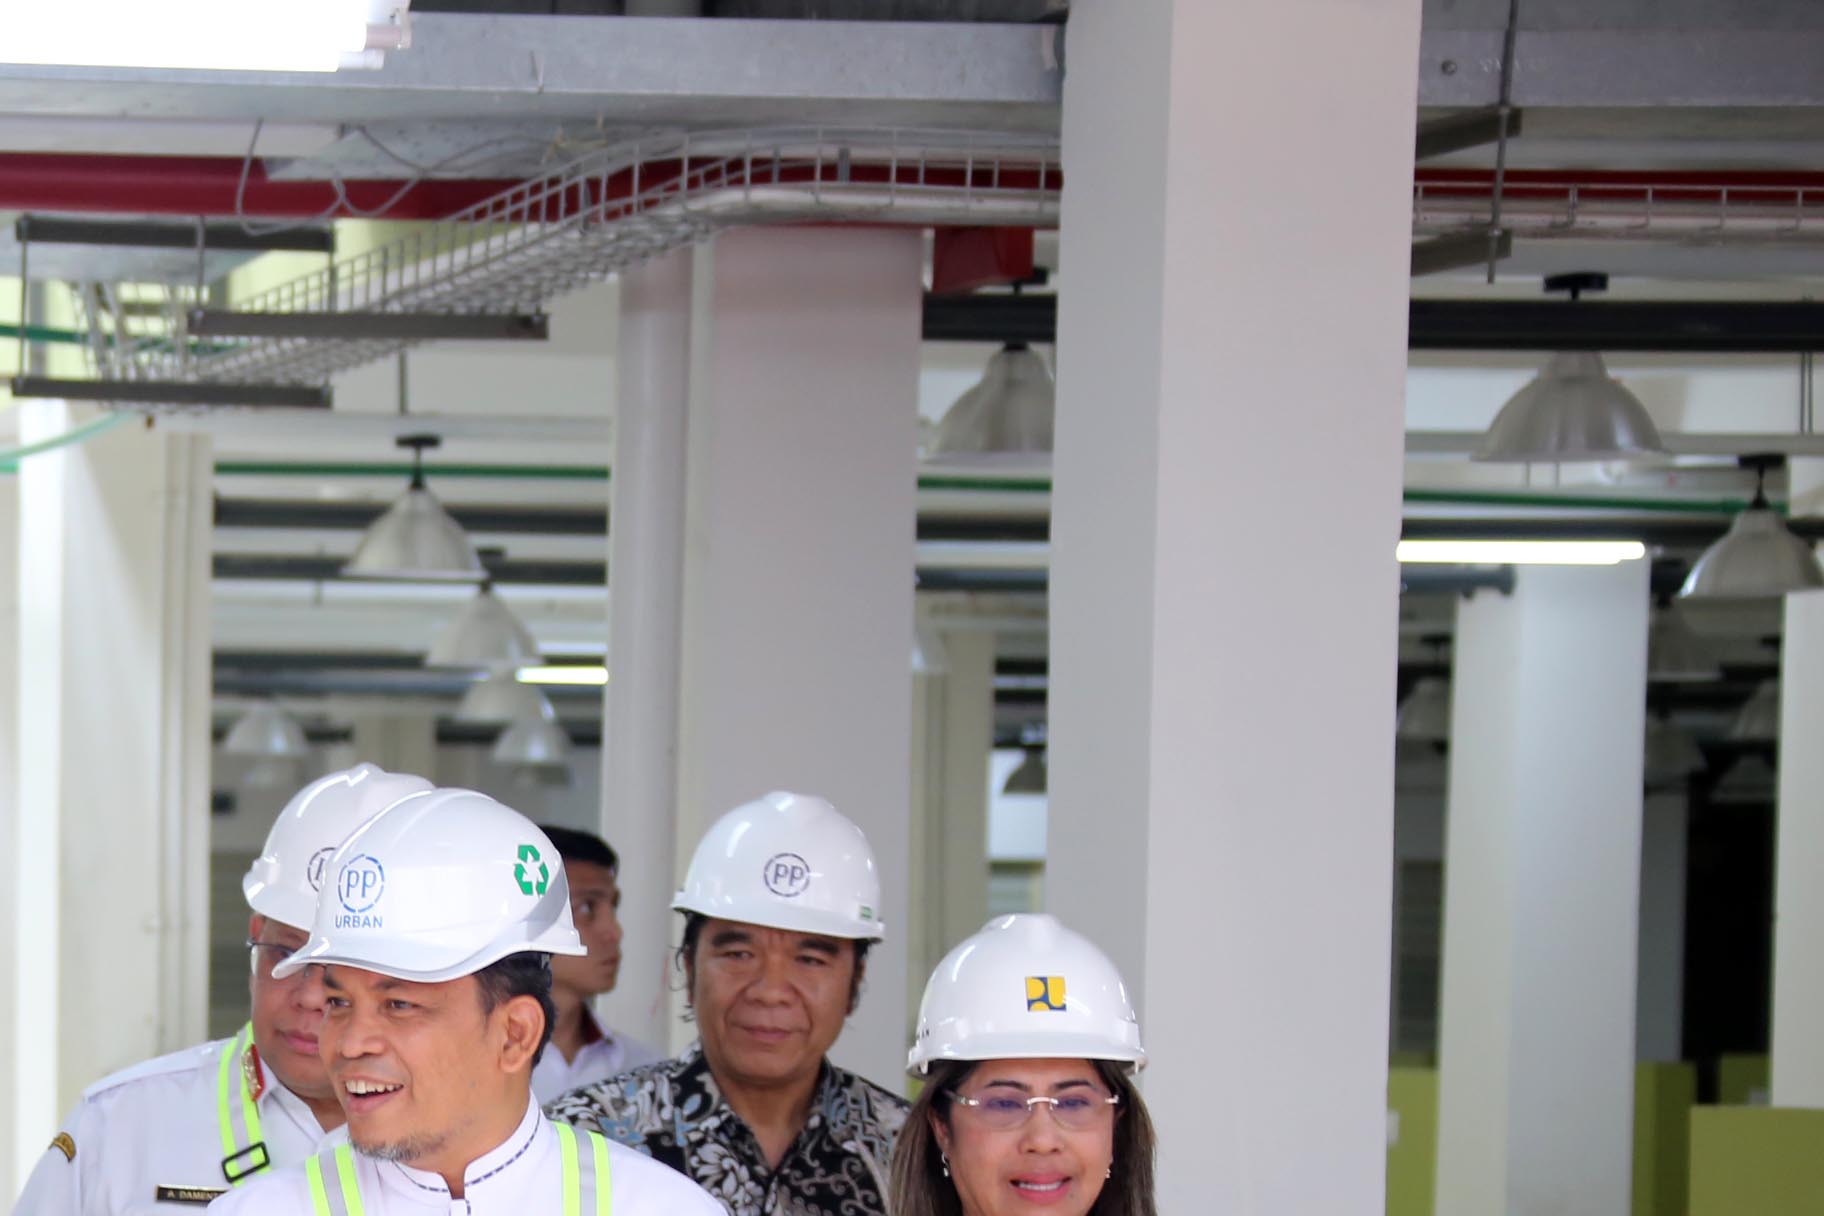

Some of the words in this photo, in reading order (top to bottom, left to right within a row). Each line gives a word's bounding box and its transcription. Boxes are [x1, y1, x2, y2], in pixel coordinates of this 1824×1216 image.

[346, 870, 377, 898] PP
[772, 863, 805, 886] PP
[335, 915, 383, 928] URBAN
